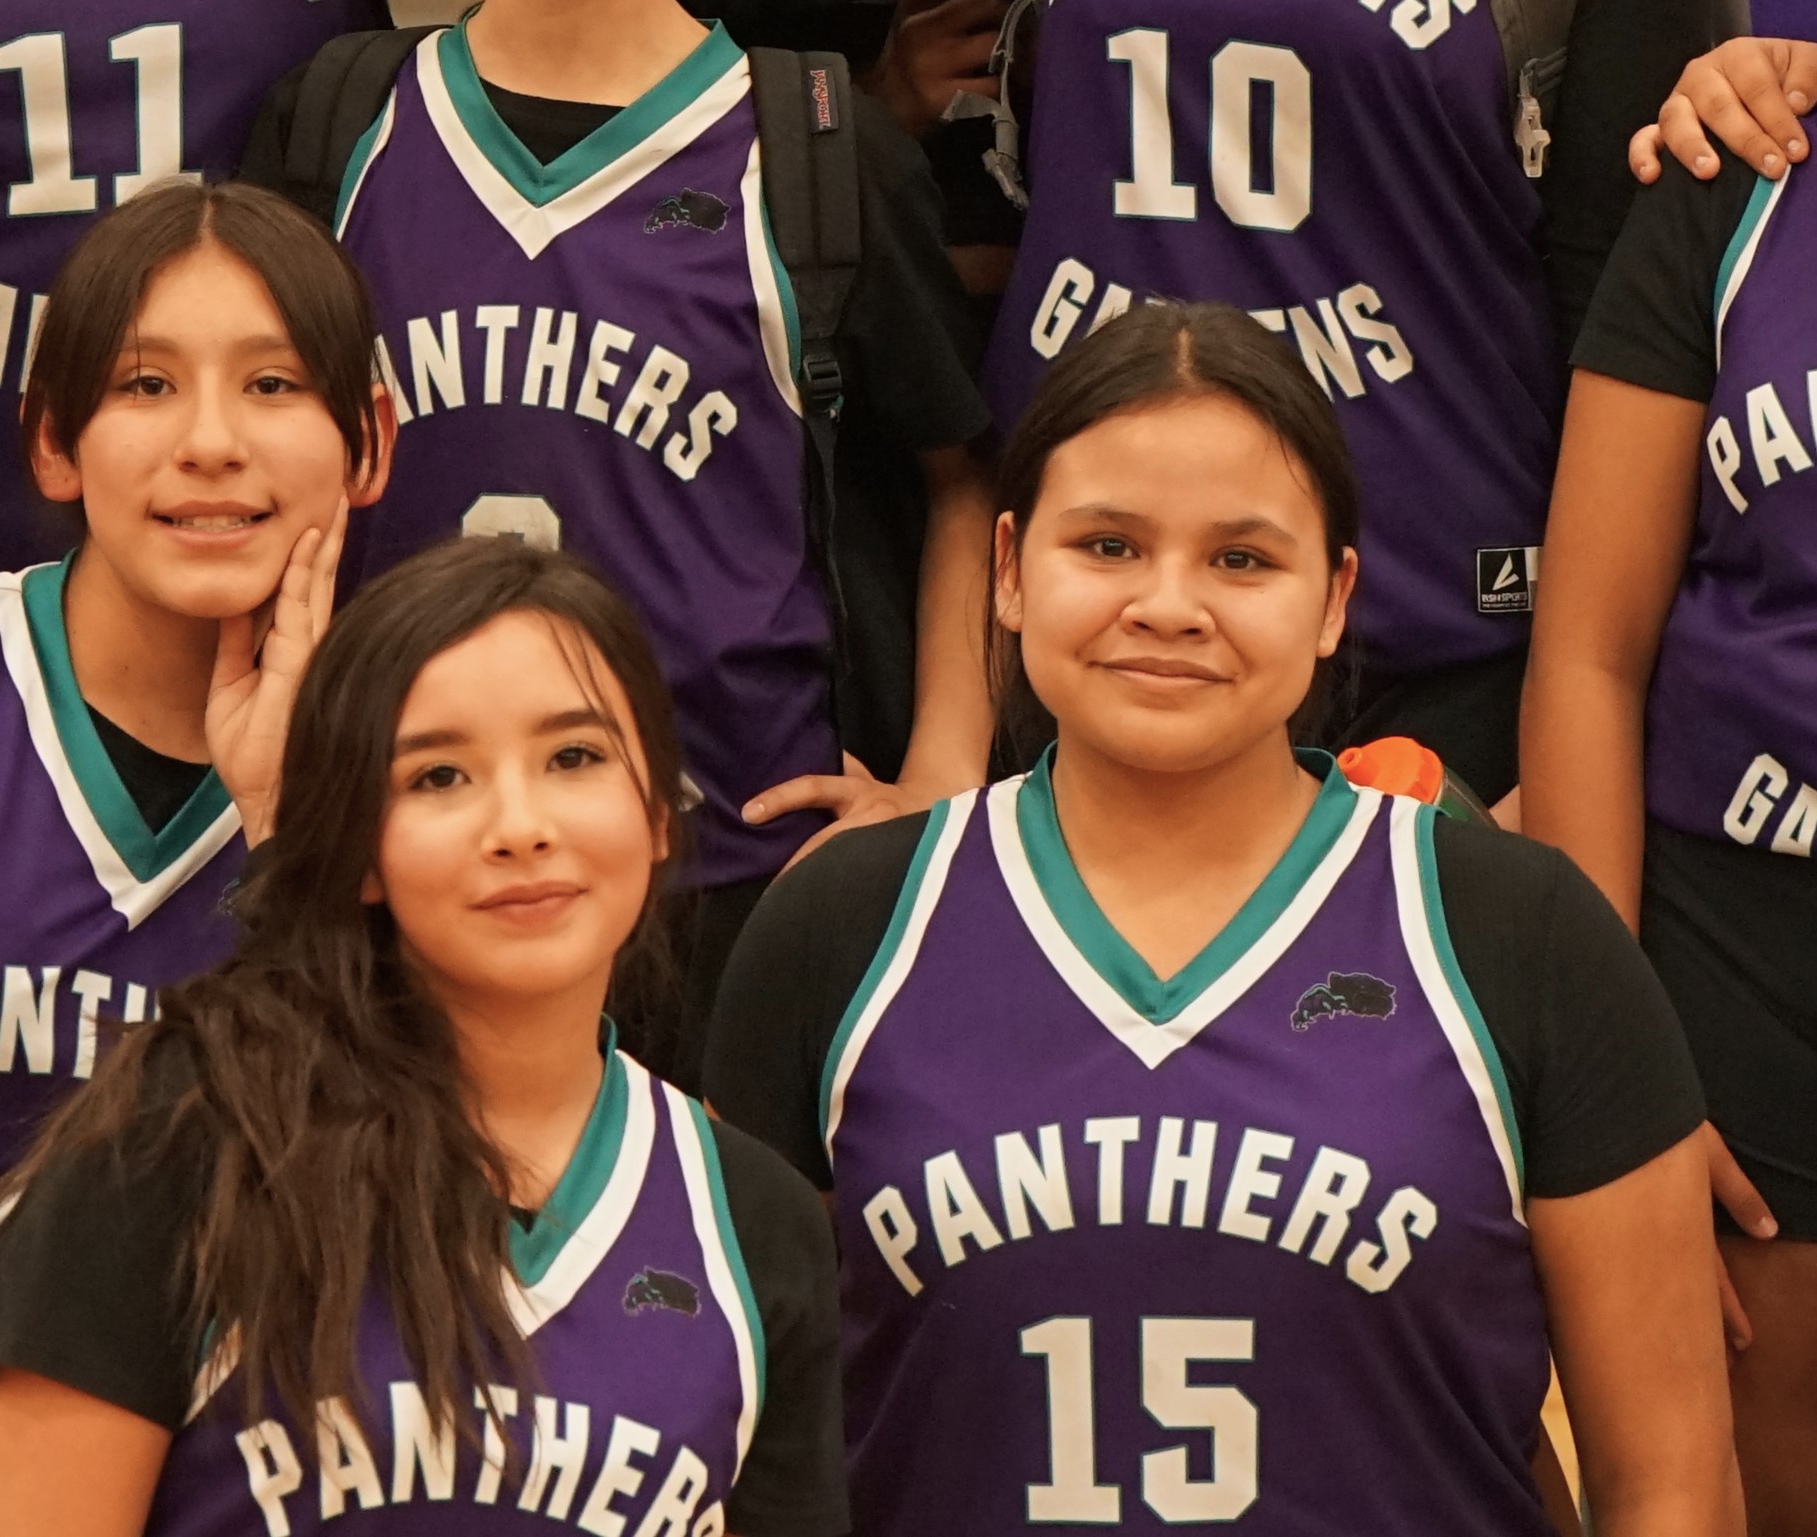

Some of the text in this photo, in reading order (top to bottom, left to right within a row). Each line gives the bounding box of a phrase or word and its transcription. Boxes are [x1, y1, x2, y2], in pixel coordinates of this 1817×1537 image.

[1105, 26, 1314, 233] 10
[372, 304, 738, 483] NTHERS
[862, 1115, 1438, 1297] PANTHERS
[1020, 1316, 1260, 1525] 15
